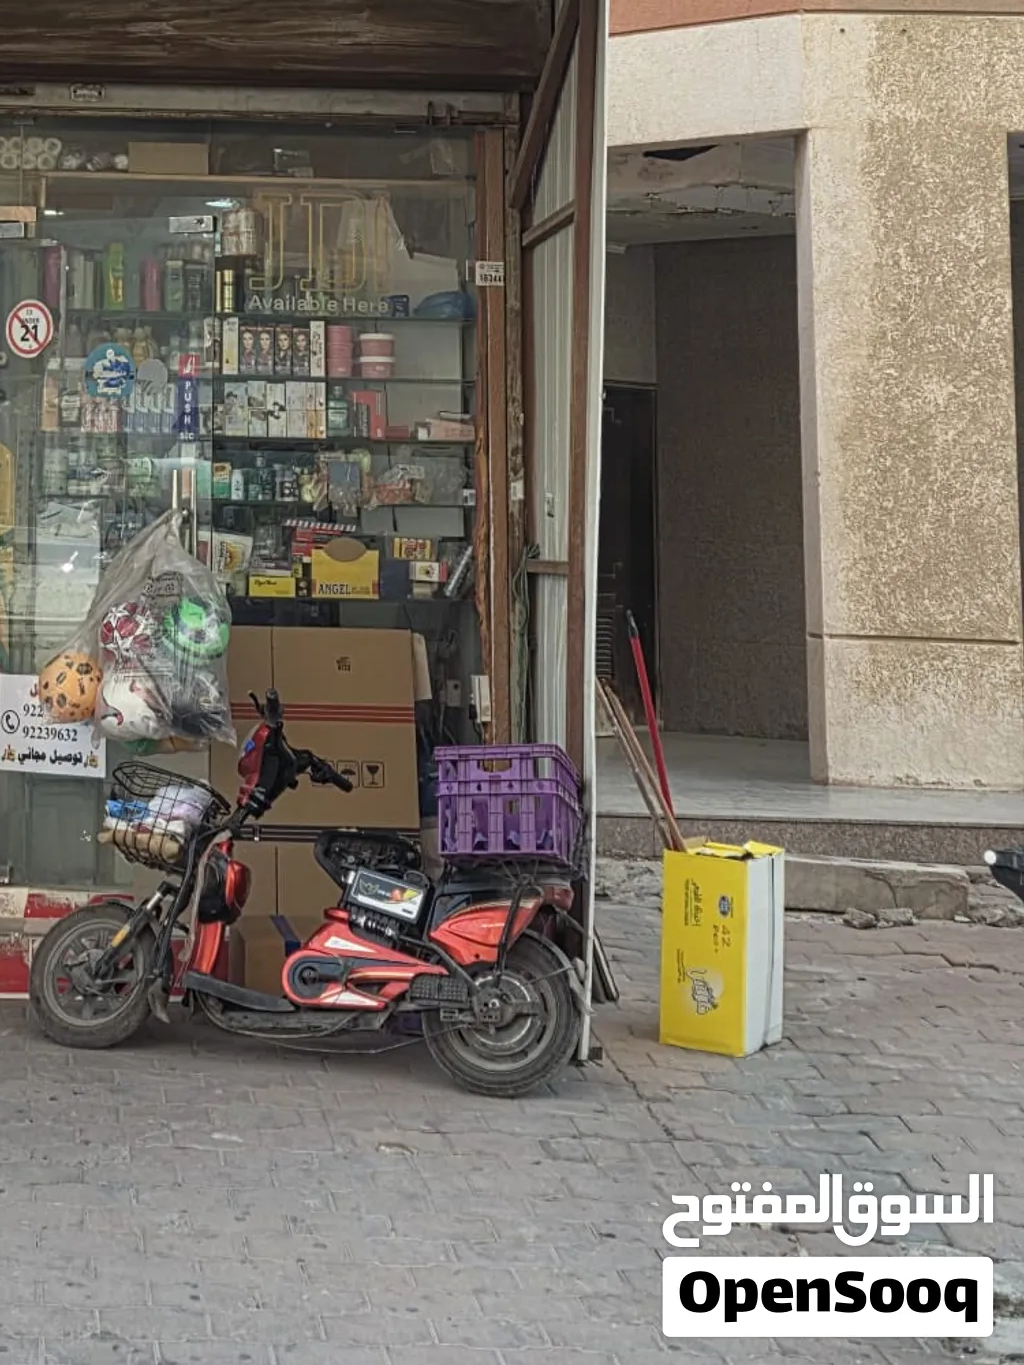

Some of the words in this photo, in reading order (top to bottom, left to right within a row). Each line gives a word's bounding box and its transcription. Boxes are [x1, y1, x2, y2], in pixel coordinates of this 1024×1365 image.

[249, 294, 338, 312] Available
[343, 297, 389, 313] Here
[20, 324, 39, 342] 21
[318, 583, 351, 595] ANGEL
[22, 725, 78, 742] 92239632
[17, 746, 47, 765] مجاني
[49, 749, 83, 766] توصيل
